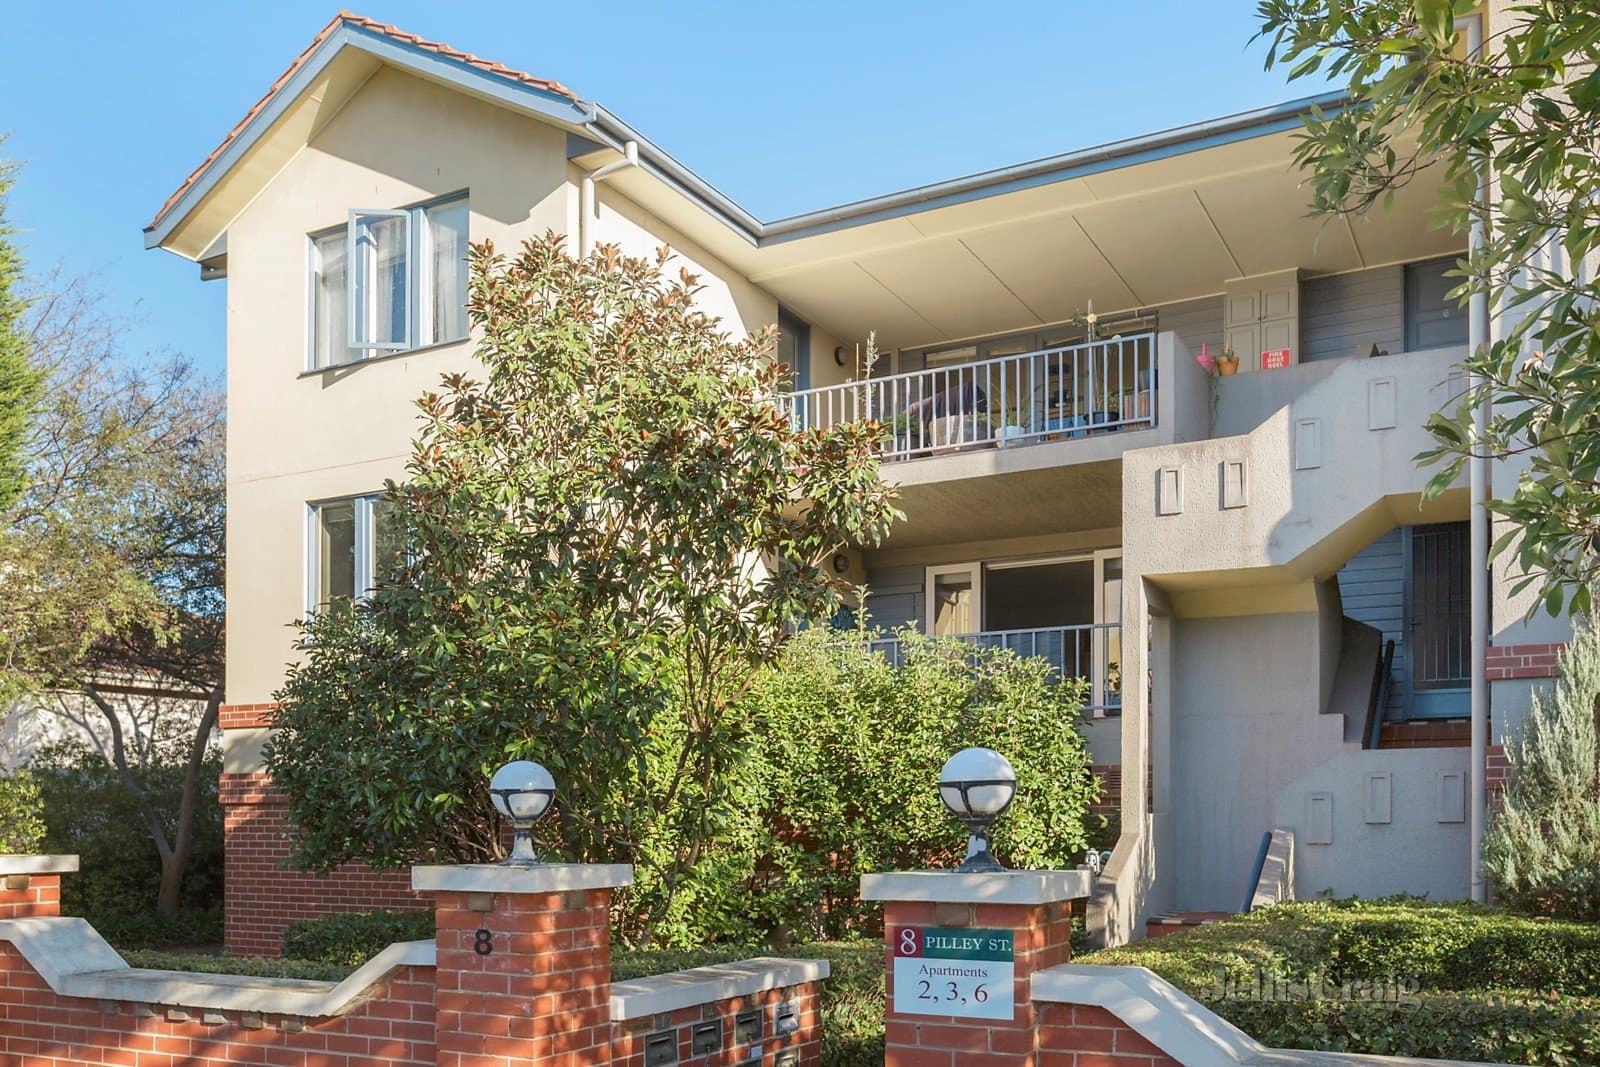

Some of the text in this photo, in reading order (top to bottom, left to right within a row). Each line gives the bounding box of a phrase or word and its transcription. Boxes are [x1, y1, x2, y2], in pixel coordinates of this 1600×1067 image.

[474, 929, 493, 955] 8
[900, 929, 1012, 955] 8 PILLEY ST.
[919, 964, 988, 977] Apartments
